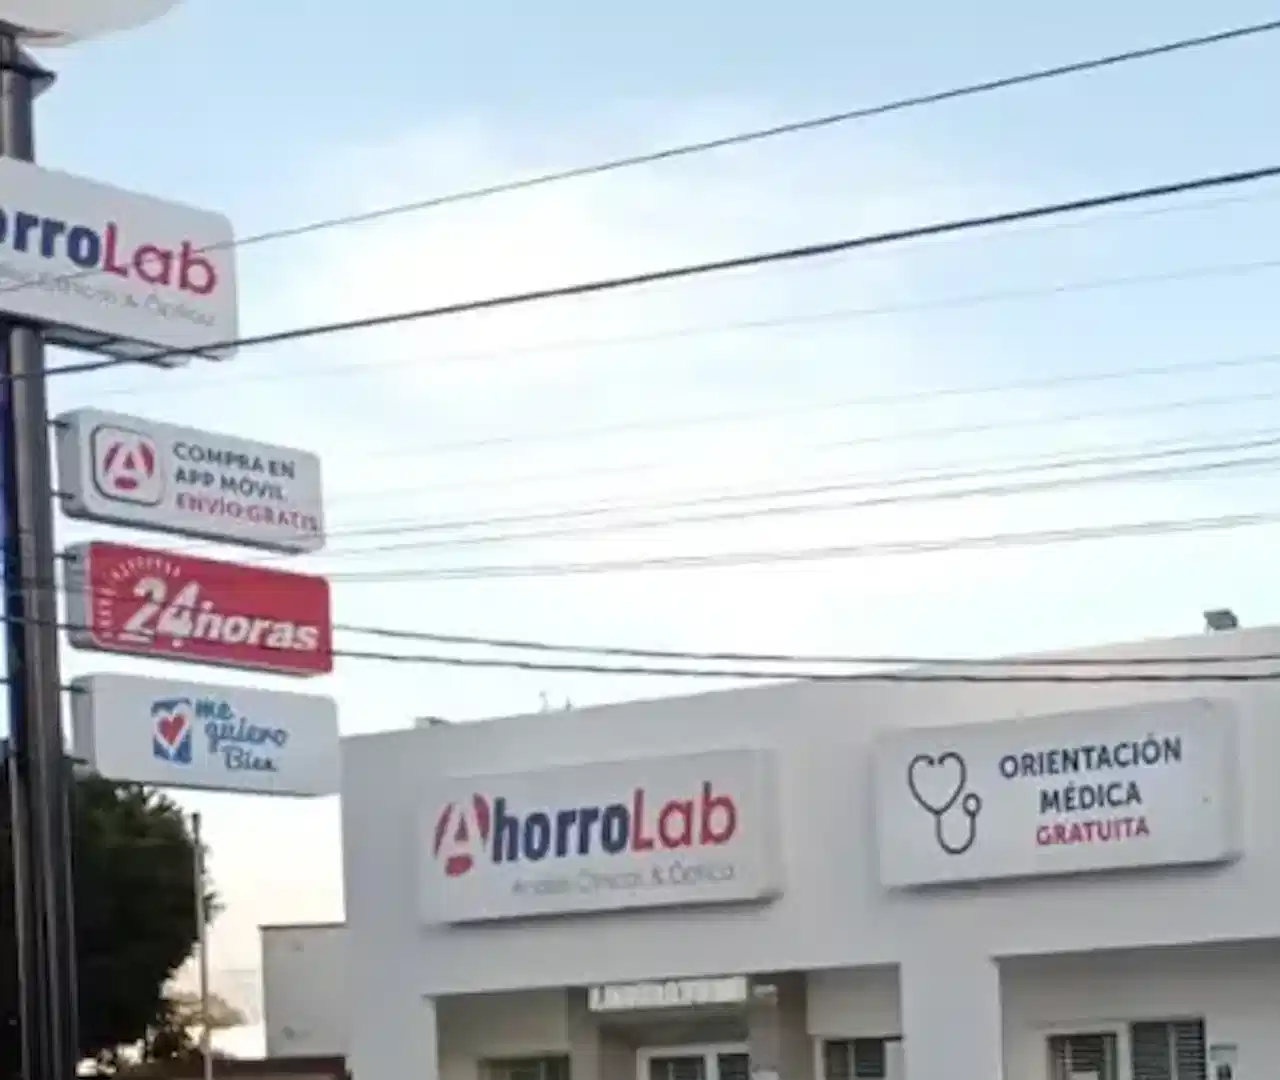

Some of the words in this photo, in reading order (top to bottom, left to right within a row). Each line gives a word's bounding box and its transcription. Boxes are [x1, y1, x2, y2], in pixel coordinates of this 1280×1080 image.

[0, 204, 216, 295] rroLab
[173, 441, 264, 473] COMPRA
[268, 460, 296, 480] EN
[175, 465, 215, 488] APP
[245, 504, 318, 531] GRATIS
[999, 735, 1184, 780] ORIENTACIÓN
[1039, 779, 1143, 815] MÉDICA
[1036, 815, 1152, 846] GRATUITA
